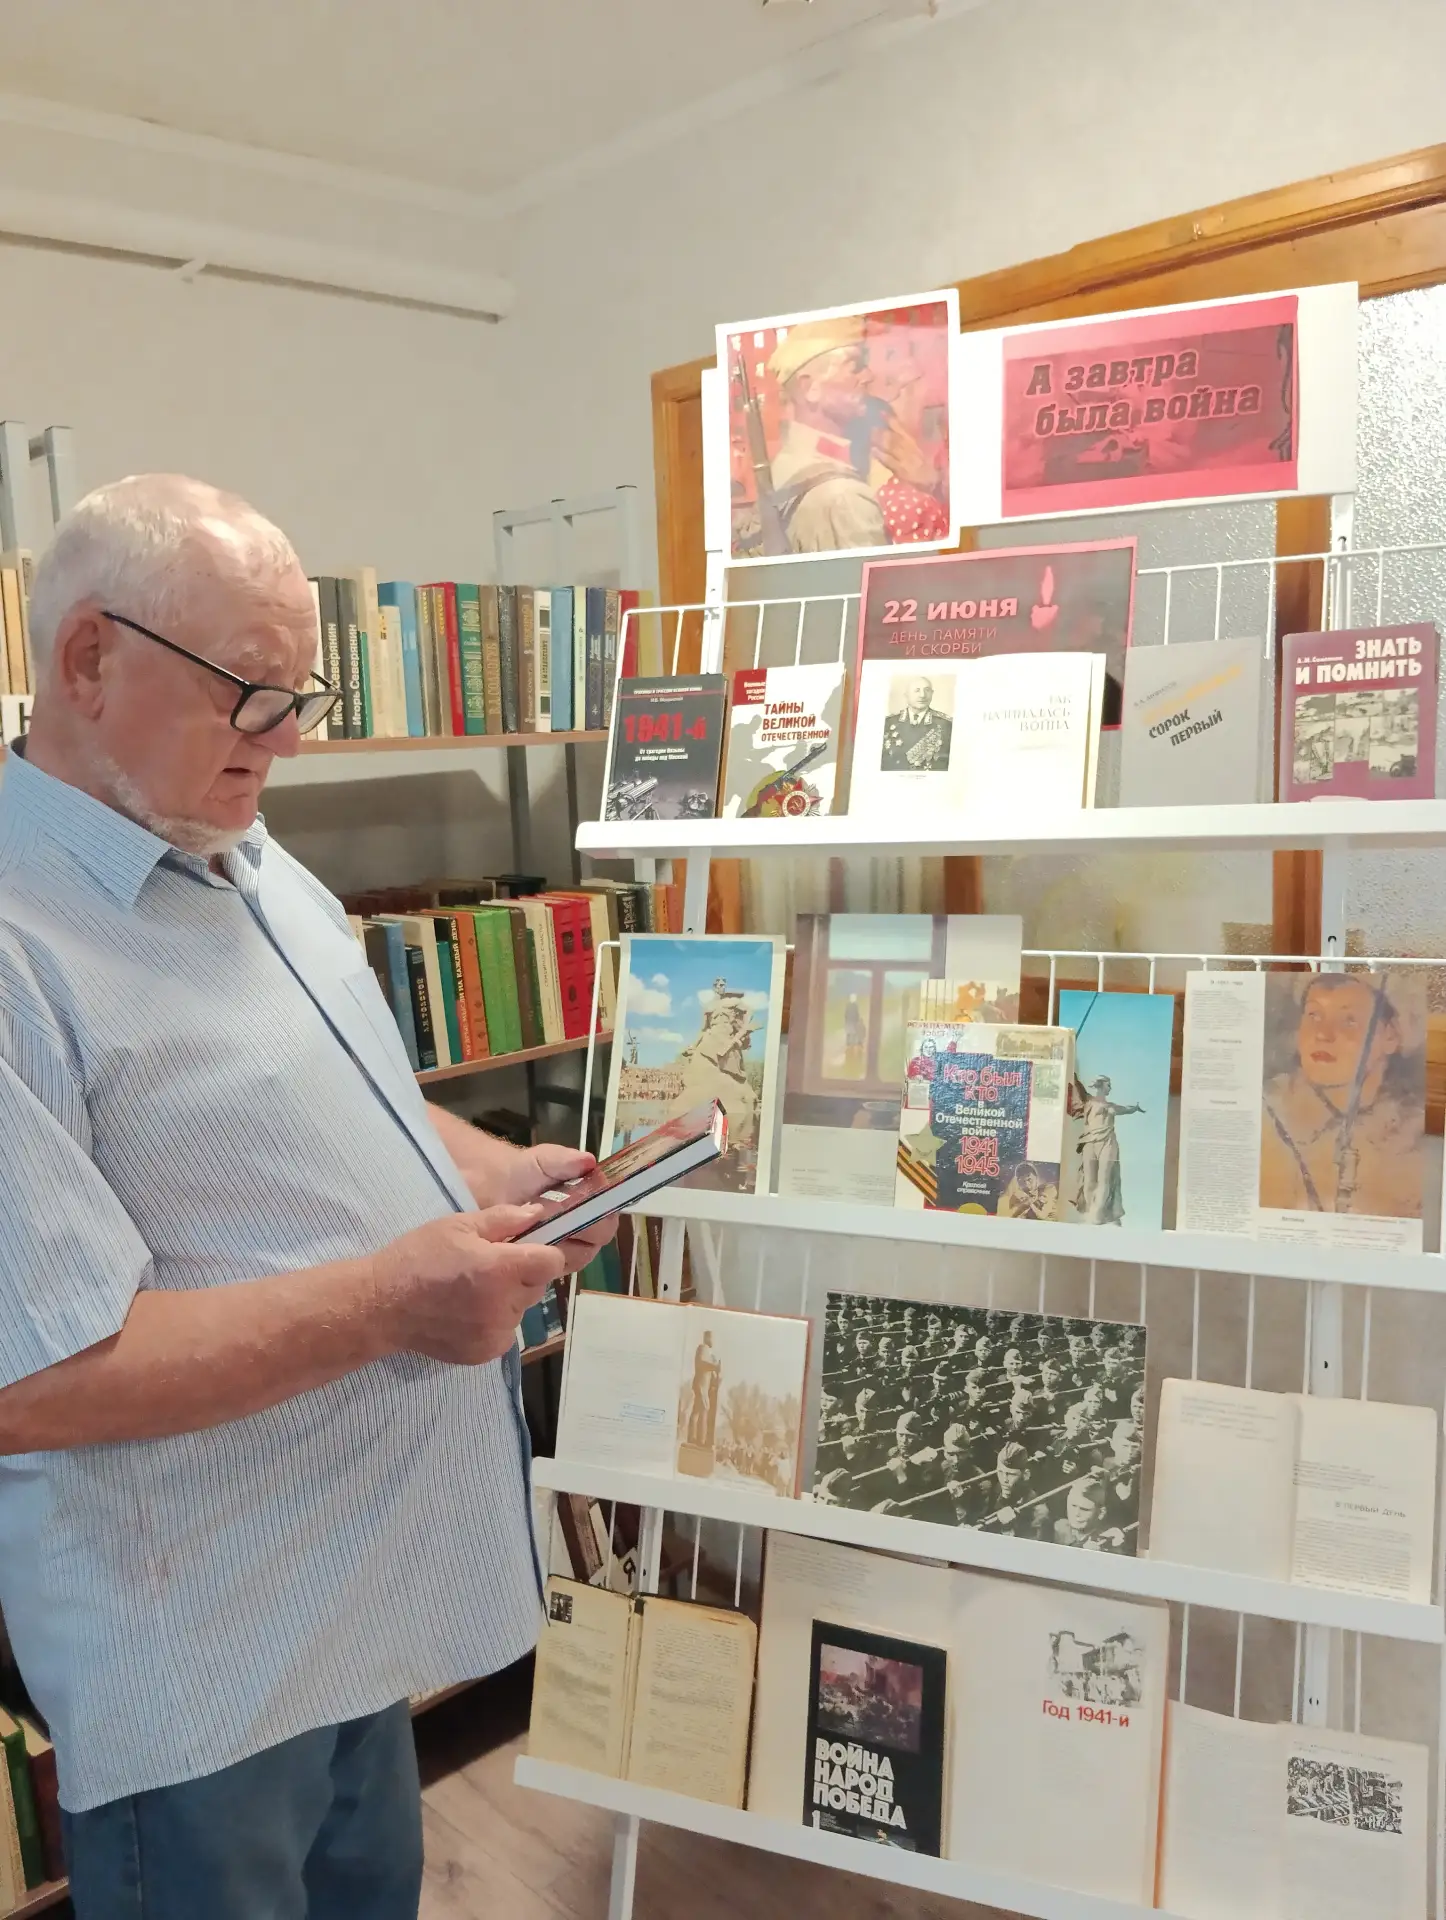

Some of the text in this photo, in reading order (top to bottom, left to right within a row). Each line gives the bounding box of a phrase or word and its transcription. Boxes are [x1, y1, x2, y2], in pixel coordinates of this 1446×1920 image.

[1026, 349, 1199, 397] А завтра
[1034, 386, 1262, 436] была война
[882, 597, 1018, 624] 22 июня
[888, 626, 998, 644] ДЕНЬ ПАМЯТИ
[904, 642, 983, 657] И СКОРБИ
[1354, 636, 1423, 660] ЗНАТЬ
[348, 623, 363, 726] Игорь Северянин
[1295, 657, 1423, 685] И ПОМНИТЬ
[764, 700, 804, 715] ТАЙНЫ
[762, 713, 816, 730] ВЕЛИКОЙ
[1148, 708, 1191, 739] СОРОК
[1169, 708, 1223, 746] ПЕРВЫЙ
[761, 729, 830, 742] ОТЕЧЕСТВЕННОЙ
[450, 919, 459, 941] ДЕНЬ
[452, 942, 463, 979] КАЖДЫЙ
[457, 979, 464, 992] НА
[943, 1063, 1023, 1086] Кто был
[935, 1112, 1024, 1129] Отечественной
[955, 1103, 1006, 1117] Великой
[961, 1126, 998, 1137] войне
[959, 1136, 999, 1157] 1941
[955, 1155, 1000, 1177] 1945
[1042, 1699, 1070, 1721] Год
[815, 1737, 895, 1781] ВОЙНА
[813, 1758, 895, 1804] НАРОД
[812, 1781, 908, 1830] ПОБЕДА
